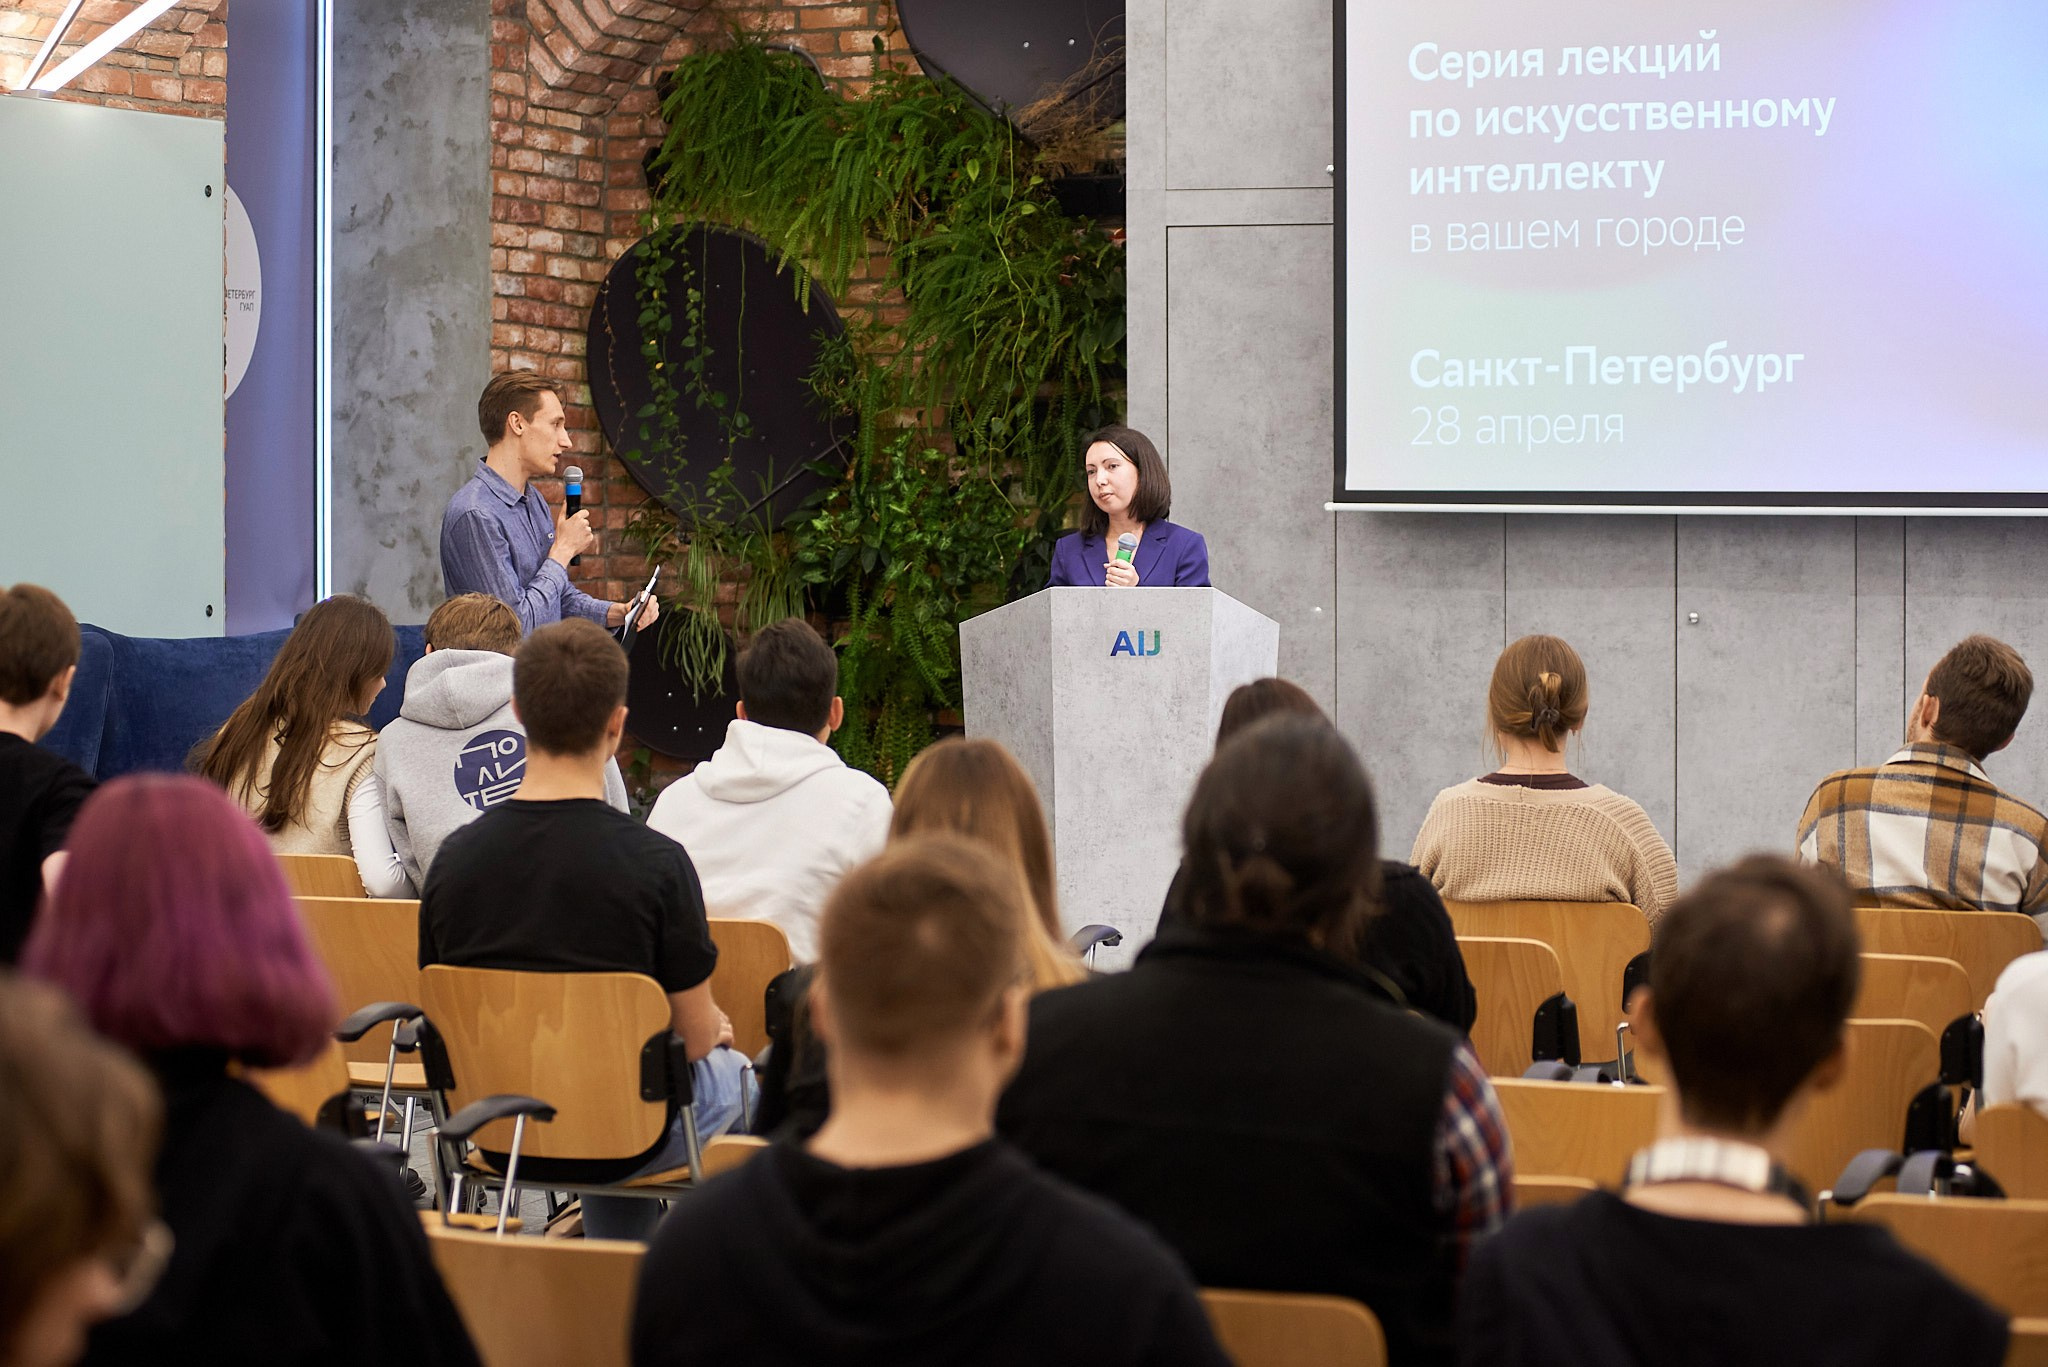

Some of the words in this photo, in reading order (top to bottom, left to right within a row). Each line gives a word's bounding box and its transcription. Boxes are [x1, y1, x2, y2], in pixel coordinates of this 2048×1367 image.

[1408, 42, 1544, 88] Серия
[1557, 29, 1721, 80] лекций
[1409, 107, 1461, 138] по
[1475, 97, 1837, 144] искусственному
[1410, 159, 1666, 198] интеллекту
[1410, 224, 1432, 253] в
[1447, 219, 1580, 252] вашем
[1596, 215, 1746, 255] городе
[227, 289, 256, 300] ЕТЕРБУРГ
[1410, 340, 1805, 394] Санкт-Петербург
[1410, 405, 1461, 445] 28
[1476, 413, 1625, 452] апреля
[1110, 630, 1161, 656] AIJ
